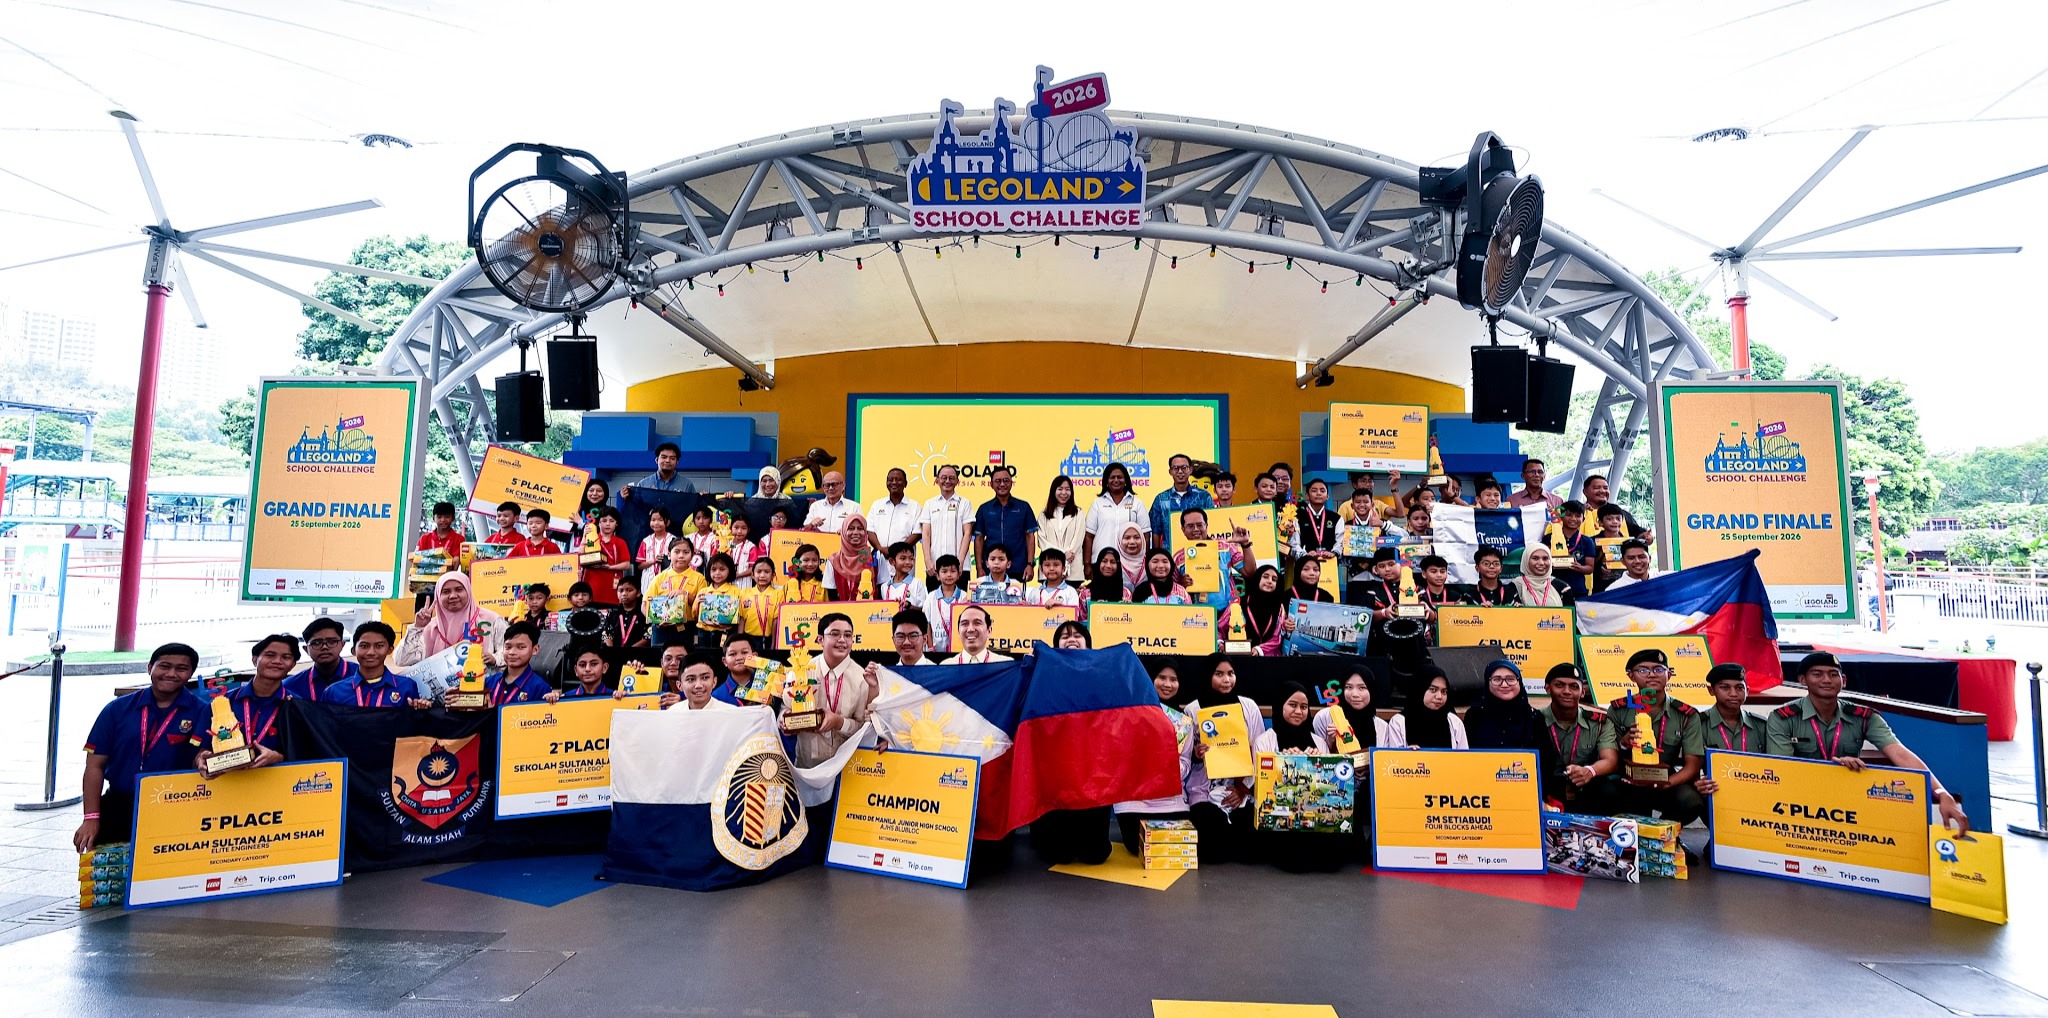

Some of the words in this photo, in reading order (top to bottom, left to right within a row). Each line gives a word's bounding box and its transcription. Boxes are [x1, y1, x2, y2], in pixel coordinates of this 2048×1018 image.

[1052, 83, 1097, 108] 2026
[914, 211, 1004, 227] SCHOOL
[1010, 210, 1140, 227] CHALLENGE
[345, 417, 361, 427] 2026
[1368, 429, 1398, 437] PLACE
[1763, 423, 1783, 434] 2026
[1114, 430, 1132, 441] 2026
[300, 452, 363, 463] LEGOLAND
[286, 465, 322, 473] SCHOOL
[324, 465, 375, 474] CHALLENGE
[1719, 460, 1791, 471] LEGOLAND
[1706, 475, 1747, 483] SCHOOL
[1749, 475, 1807, 483] CHALLENGE
[520, 480, 554, 494] PLACE
[515, 490, 553, 504] CYBERJAYA
[264, 501, 326, 517] GRAND
[330, 503, 392, 518] FINALE
[290, 520, 299, 528] 25
[300, 520, 341, 529] September
[343, 521, 361, 529] 2026
[1687, 514, 1759, 529] GRAND
[1763, 514, 1832, 529] FINALE
[1477, 532, 1512, 546] Temple
[1721, 533, 1731, 541] 25
[1732, 533, 1779, 542] September
[1780, 533, 1801, 541] 2026
[315, 582, 340, 590] Trip.com
[355, 582, 385, 591] LEGOLAND
[1804, 597, 1839, 605] LEGOLAND
[1138, 637, 1177, 648] PLACE
[461, 646, 468, 655] 2
[520, 717, 557, 727] LEGOLAND
[1205, 722, 1212, 731] 3
[514, 762, 557, 773] SEKOLAH
[558, 760, 594, 769] SULTAN
[856, 765, 886, 775] LEGOLAND
[1340, 765, 1350, 776] 3
[1392, 766, 1431, 775] LEGOLAND
[1734, 771, 1780, 782] LEGOLAND
[164, 788, 212, 800] LEGOLAND
[456, 790, 472, 804] JAYA
[401, 794, 417, 808] CHITA
[462, 780, 491, 821] PUTRAJAYA
[868, 793, 940, 814] CHAMPION
[1440, 796, 1491, 809] PLACE
[381, 791, 406, 825] SULTAN
[421, 806, 451, 814] USAHA
[1790, 804, 1858, 824] PLACE
[220, 811, 283, 830] PLACE
[846, 813, 866, 821] ATENEO
[875, 817, 896, 825] MANILA
[934, 824, 958, 833] SCHOOL
[1426, 816, 1440, 824] SM
[1442, 816, 1491, 824] SETIABUDI
[894, 826, 920, 834] BLUBLOC
[1741, 818, 1790, 832] MAKTAB
[1790, 824, 1846, 839] TENTERA
[1849, 832, 1896, 846] DIRAJA
[153, 840, 210, 854] SEKOLAH
[212, 836, 257, 850] SULTAN
[258, 832, 292, 844] ALAM
[293, 829, 325, 840] SHAH
[404, 834, 432, 844] ALAM
[435, 829, 462, 843] SHAH
[1776, 830, 1808, 841] PUTERA
[1809, 835, 1858, 847] ARMYCORP
[211, 846, 230, 854] ELITE
[231, 842, 270, 852] ENGINEERS
[1786, 843, 1818, 852] SECONDARY
[1818, 848, 1848, 856] CATEGORY
[1941, 842, 1950, 852] 4
[210, 857, 242, 865] SECONDARY
[242, 854, 270, 862] CATEGORY
[1478, 856, 1508, 865] Trip.com
[908, 861, 934, 872] Trip.com
[1786, 862, 1799, 870] LEGO
[259, 873, 296, 884] Trip.com
[1839, 871, 1880, 884] Trip.com
[1951, 872, 1987, 883] LEGOLAND
[206, 880, 221, 890] LEGO
